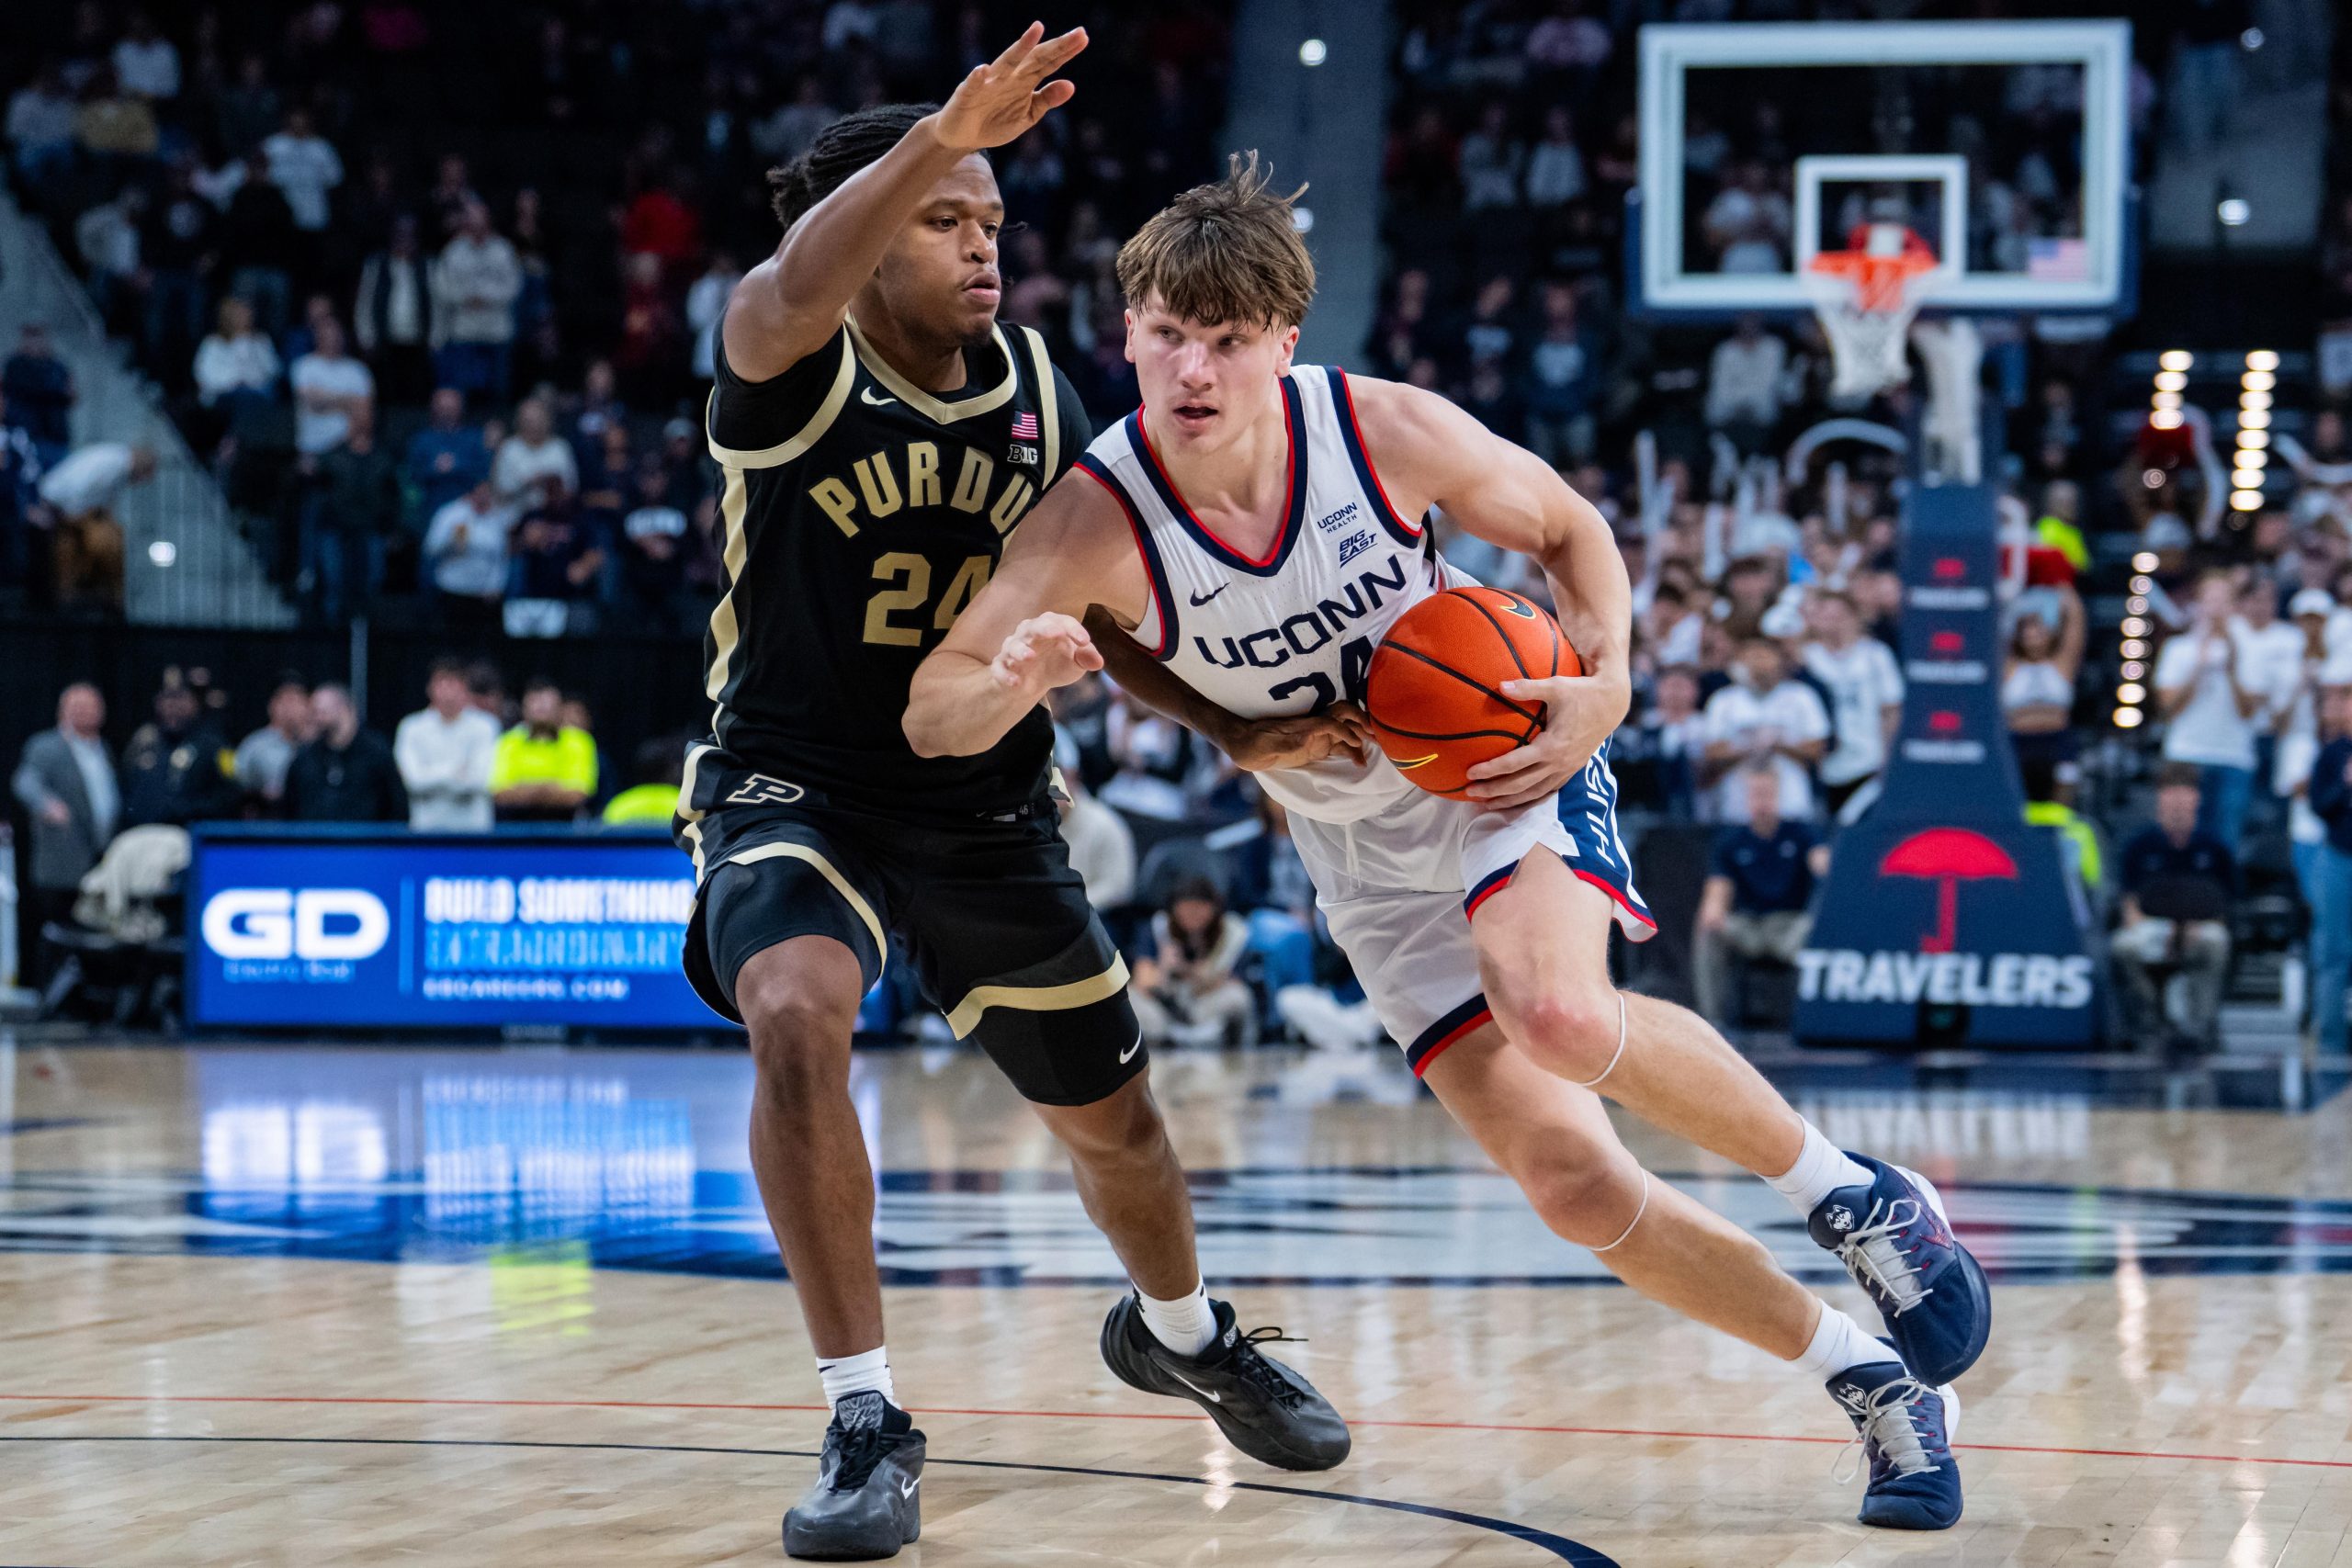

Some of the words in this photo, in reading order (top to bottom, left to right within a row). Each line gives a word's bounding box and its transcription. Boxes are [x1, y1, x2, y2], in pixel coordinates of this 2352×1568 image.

[808, 441, 1035, 549] PURDU
[1317, 502, 1358, 529] UCONN
[1327, 513, 1357, 534] HEALTH
[1340, 529, 1365, 552] BIG
[1340, 533, 1377, 562] EAST
[1193, 554, 1407, 669] UCONN
[726, 773, 805, 804] P
[424, 877, 515, 924] BUILD
[201, 887, 390, 960] GD
[1796, 951, 2094, 1008] TRAVELERS
